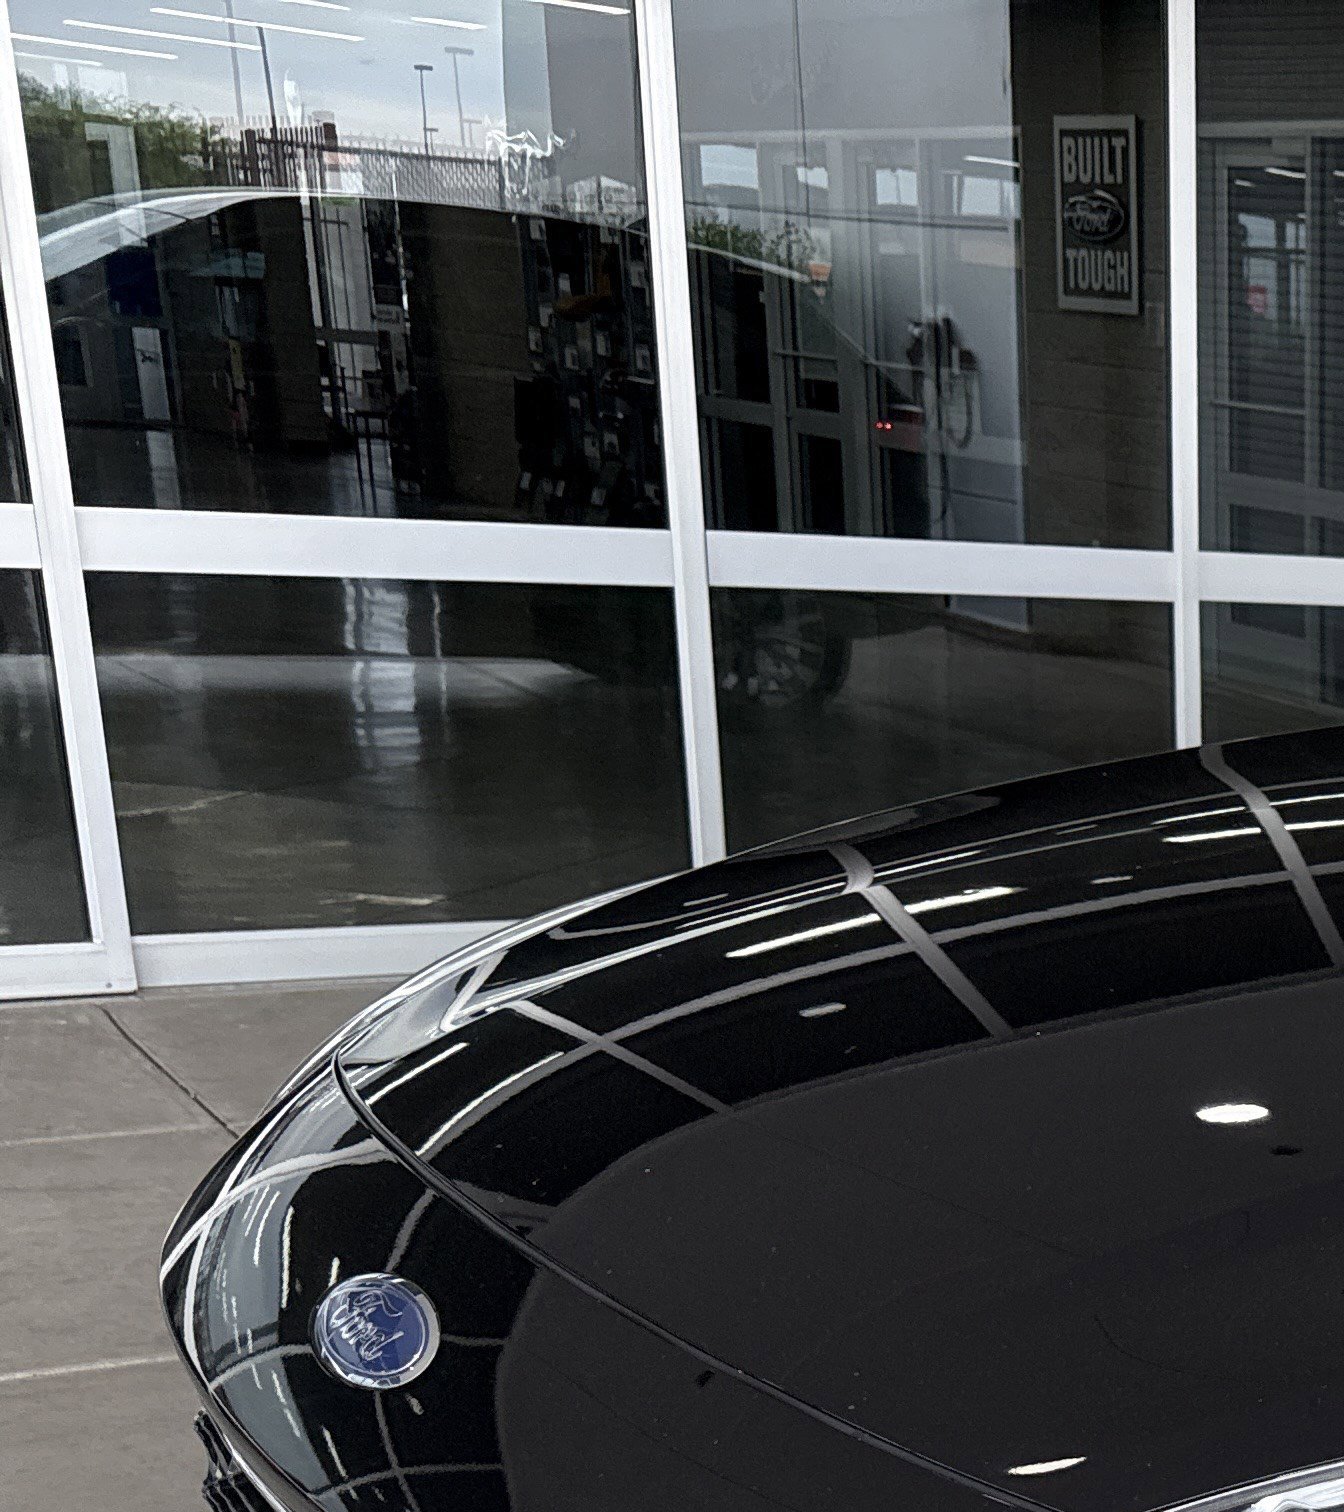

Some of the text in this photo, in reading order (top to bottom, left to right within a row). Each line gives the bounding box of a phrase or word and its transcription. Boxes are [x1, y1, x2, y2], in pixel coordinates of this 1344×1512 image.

[1061, 135, 1127, 185] BUILT
[1064, 200, 1112, 234] Ford
[1066, 248, 1129, 293] TOUGH
[330, 1290, 404, 1361] Ford
